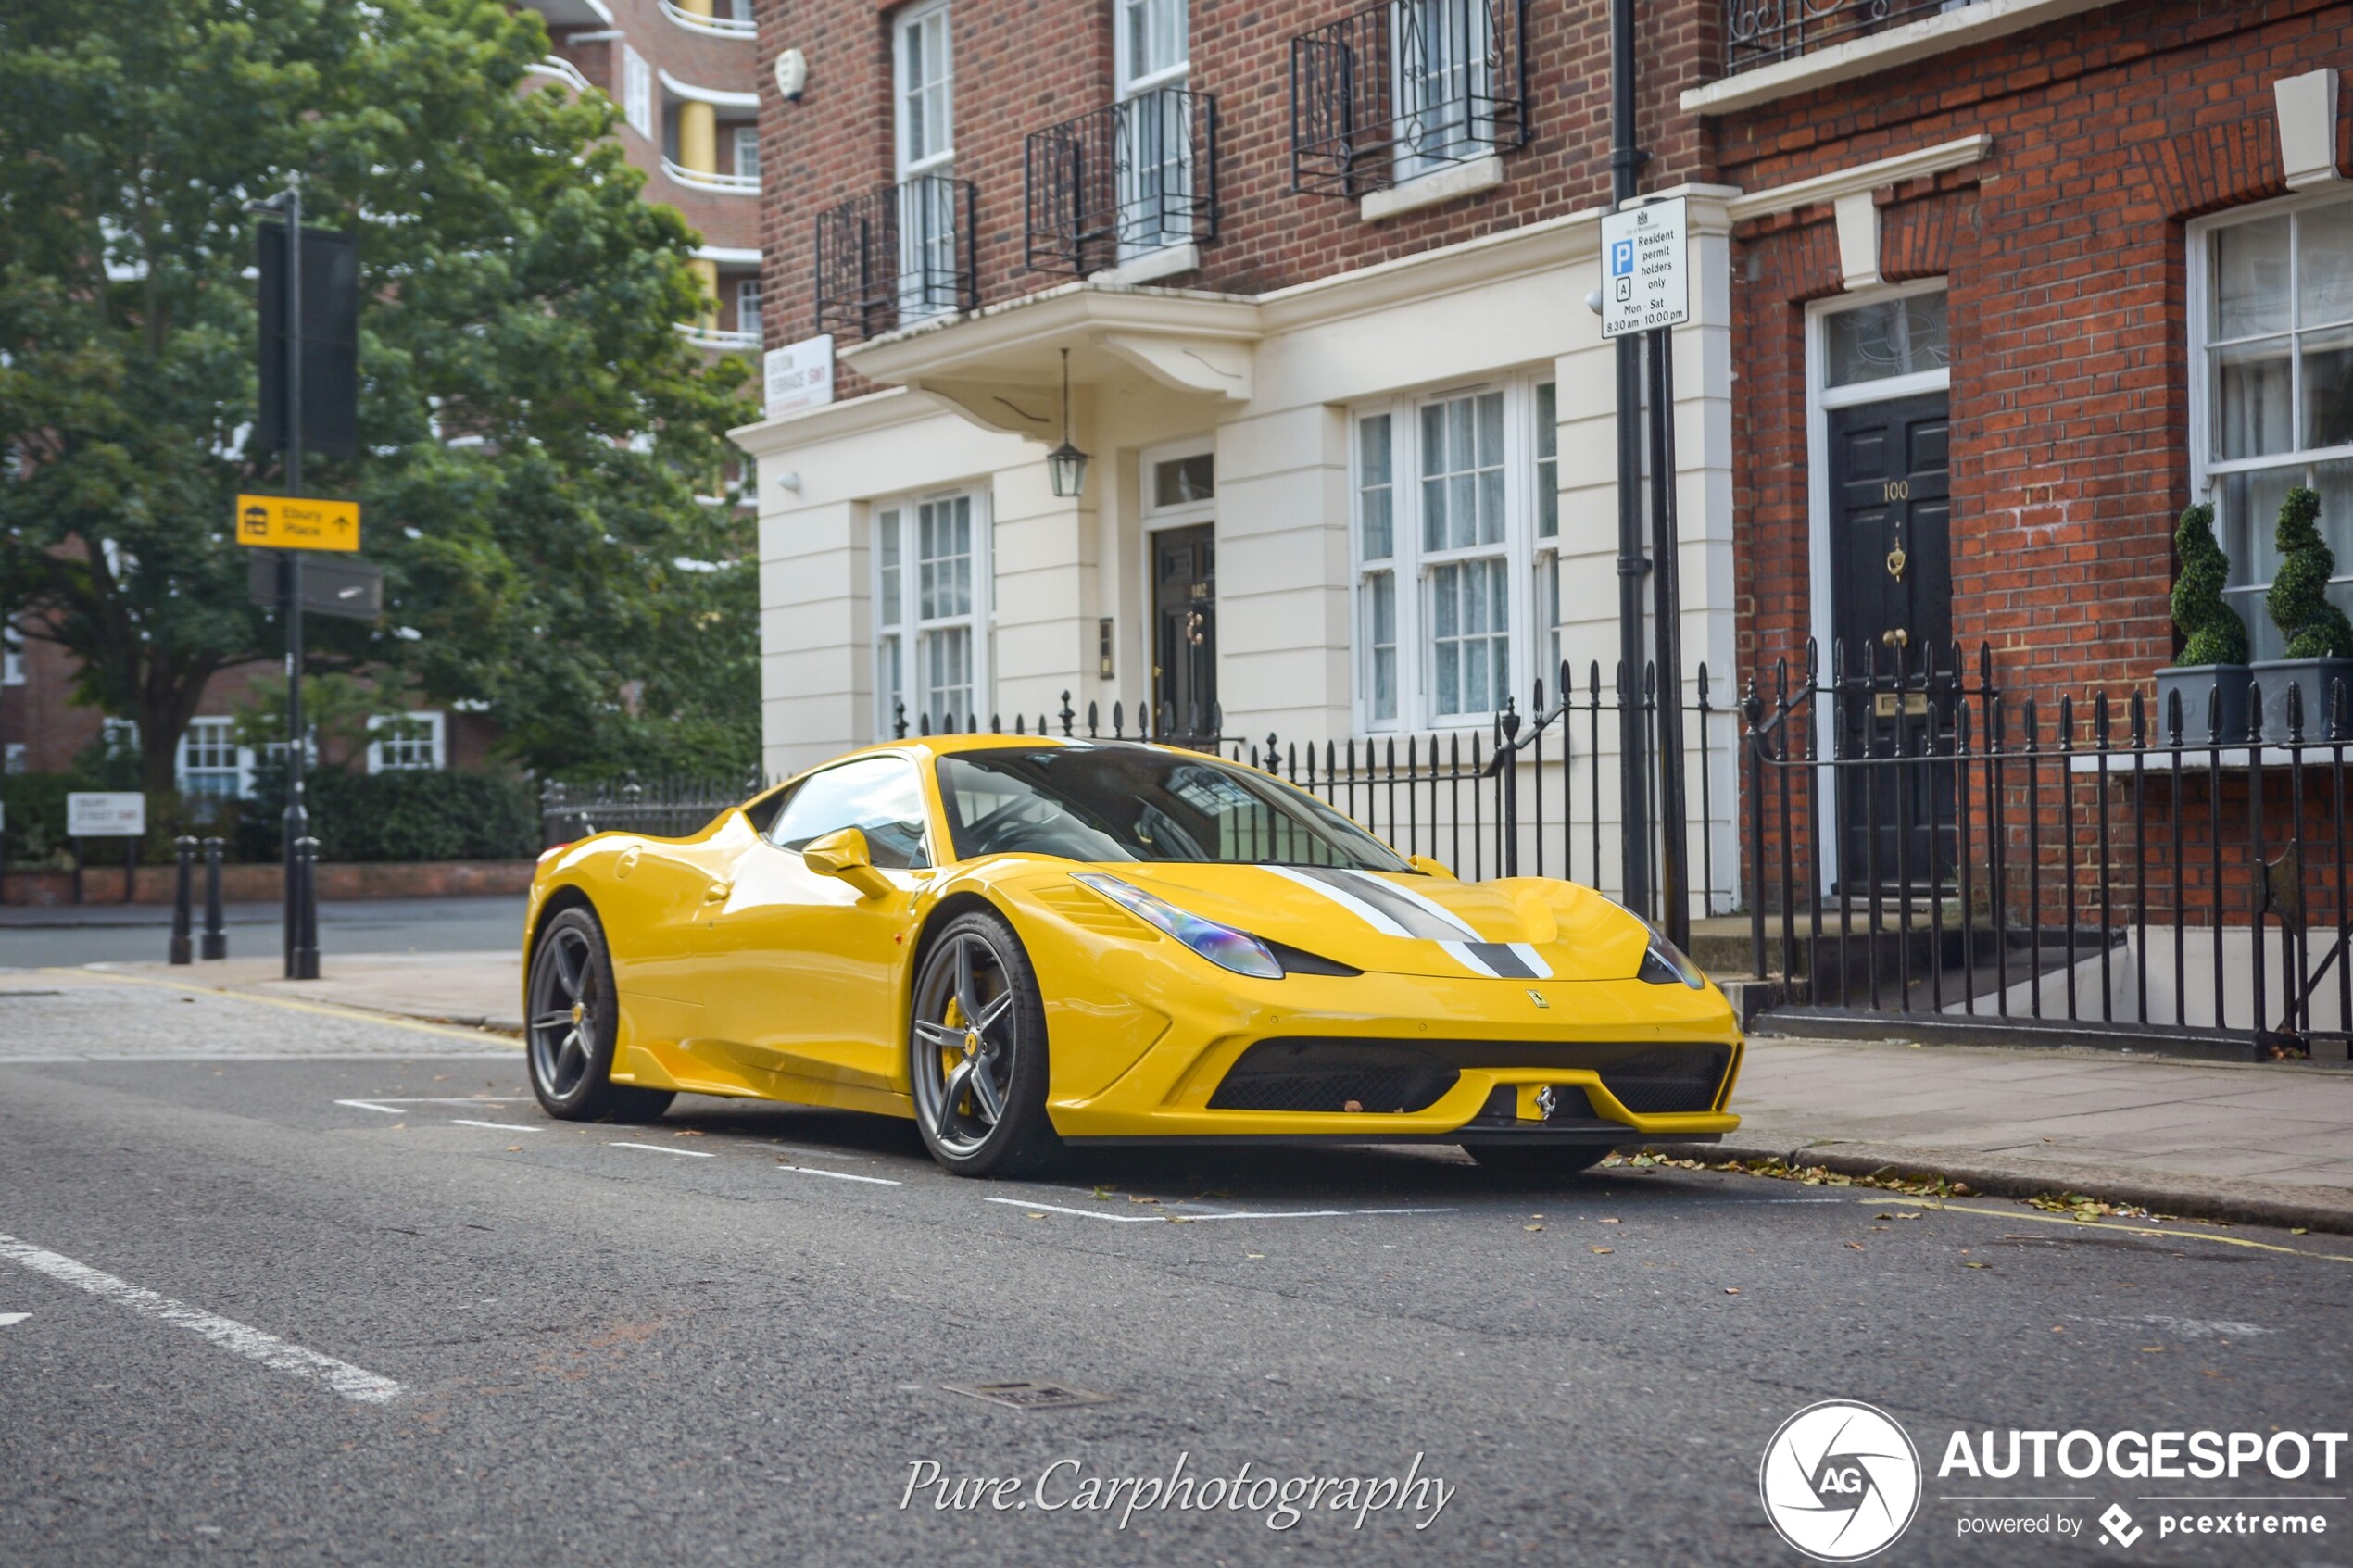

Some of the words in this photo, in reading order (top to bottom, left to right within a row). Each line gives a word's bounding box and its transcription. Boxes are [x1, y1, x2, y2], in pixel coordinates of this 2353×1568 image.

[1638, 230, 1674, 247] Resident
[1616, 243, 1630, 273] P
[1642, 246, 1669, 262] permit
[1641, 261, 1672, 276] holders
[1620, 283, 1627, 295] A
[1648, 278, 1666, 289] only
[1624, 303, 1642, 315] Mon
[1650, 297, 1664, 308] Sat
[1606, 319, 1625, 332] 8.30
[1627, 320, 1639, 329] am
[1644, 311, 1669, 325] 10.00
[1670, 309, 1683, 322] pm
[1883, 480, 1909, 502] 100
